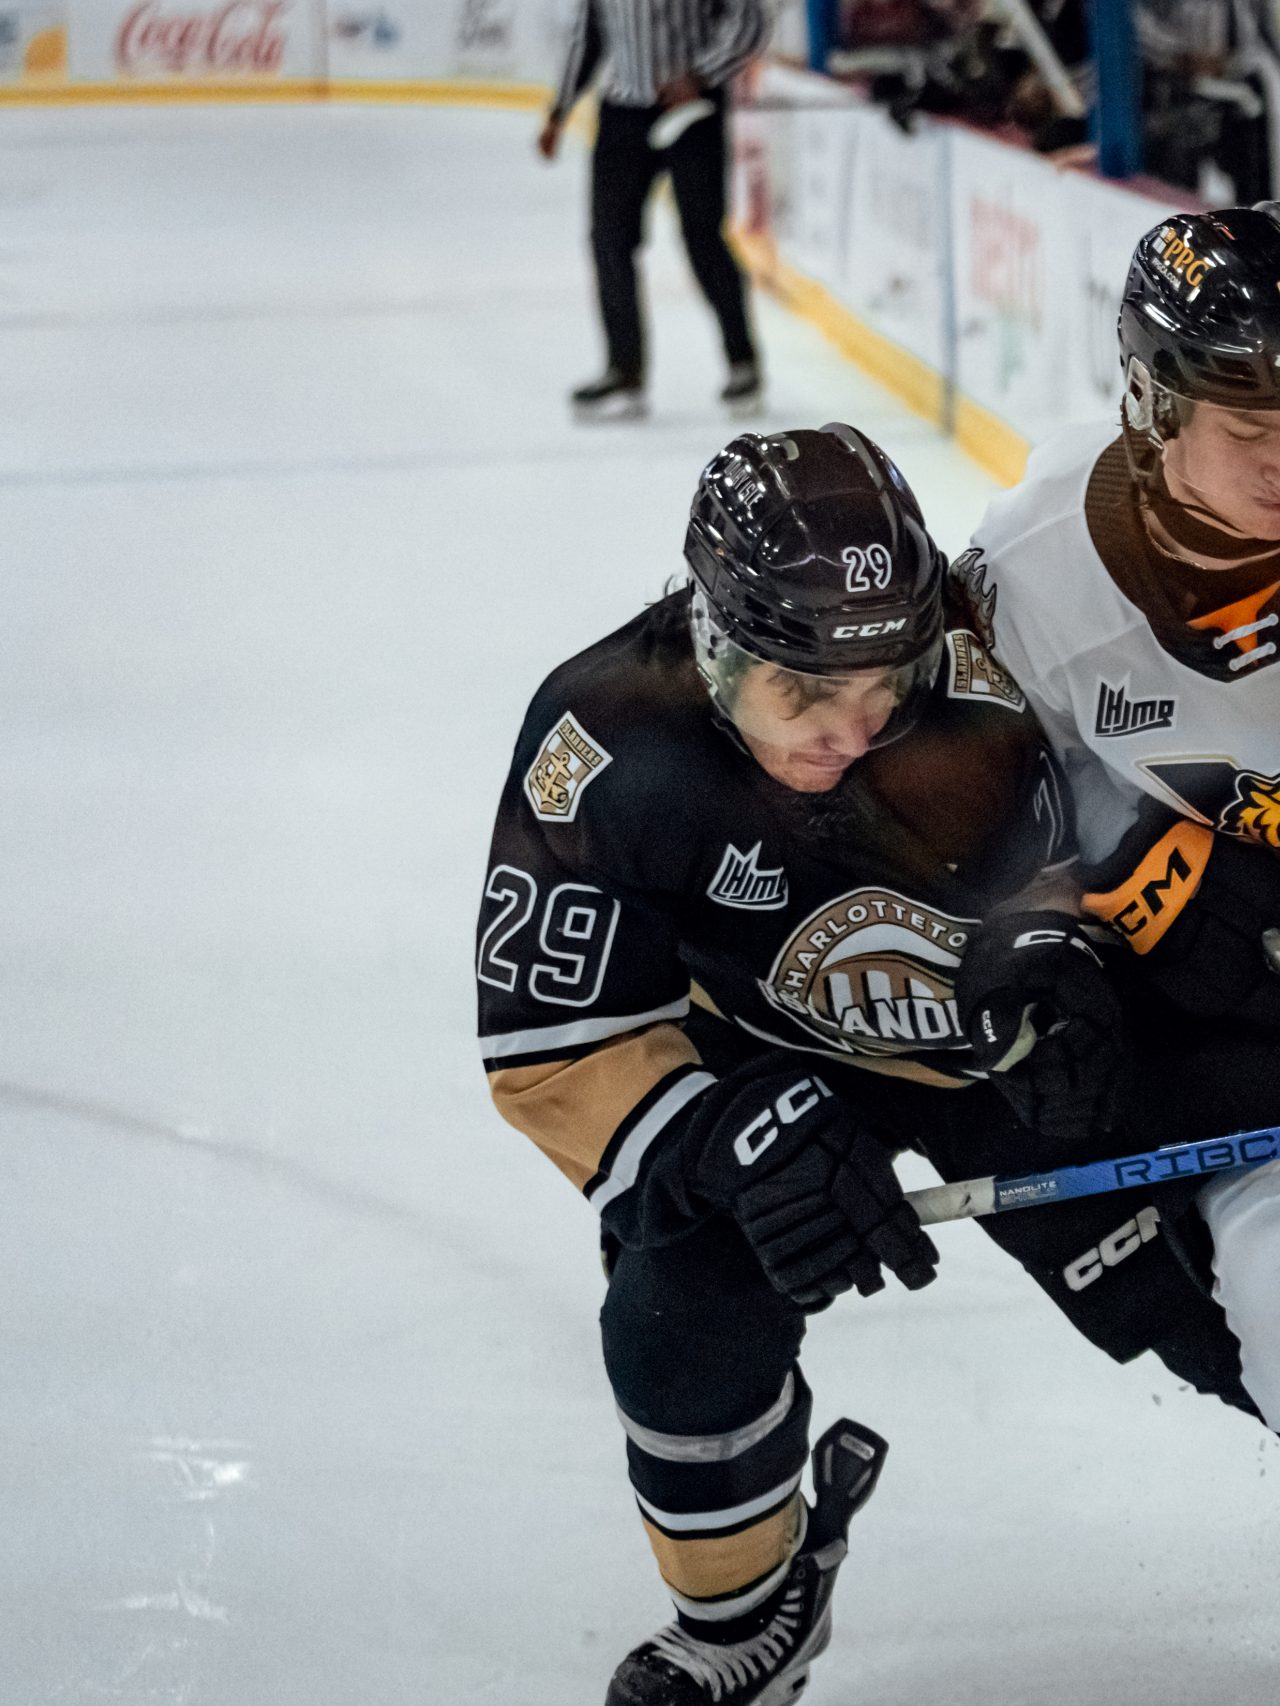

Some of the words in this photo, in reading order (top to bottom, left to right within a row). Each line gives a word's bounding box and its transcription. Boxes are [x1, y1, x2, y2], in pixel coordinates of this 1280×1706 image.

[1163, 238, 1209, 287] PPG
[842, 544, 892, 592] 29
[833, 618, 906, 639] CCM
[1113, 847, 1192, 936] CM
[477, 865, 621, 1008] 29
[982, 1010, 997, 1042] CCM
[1000, 1181, 1056, 1196] NANOLITE
